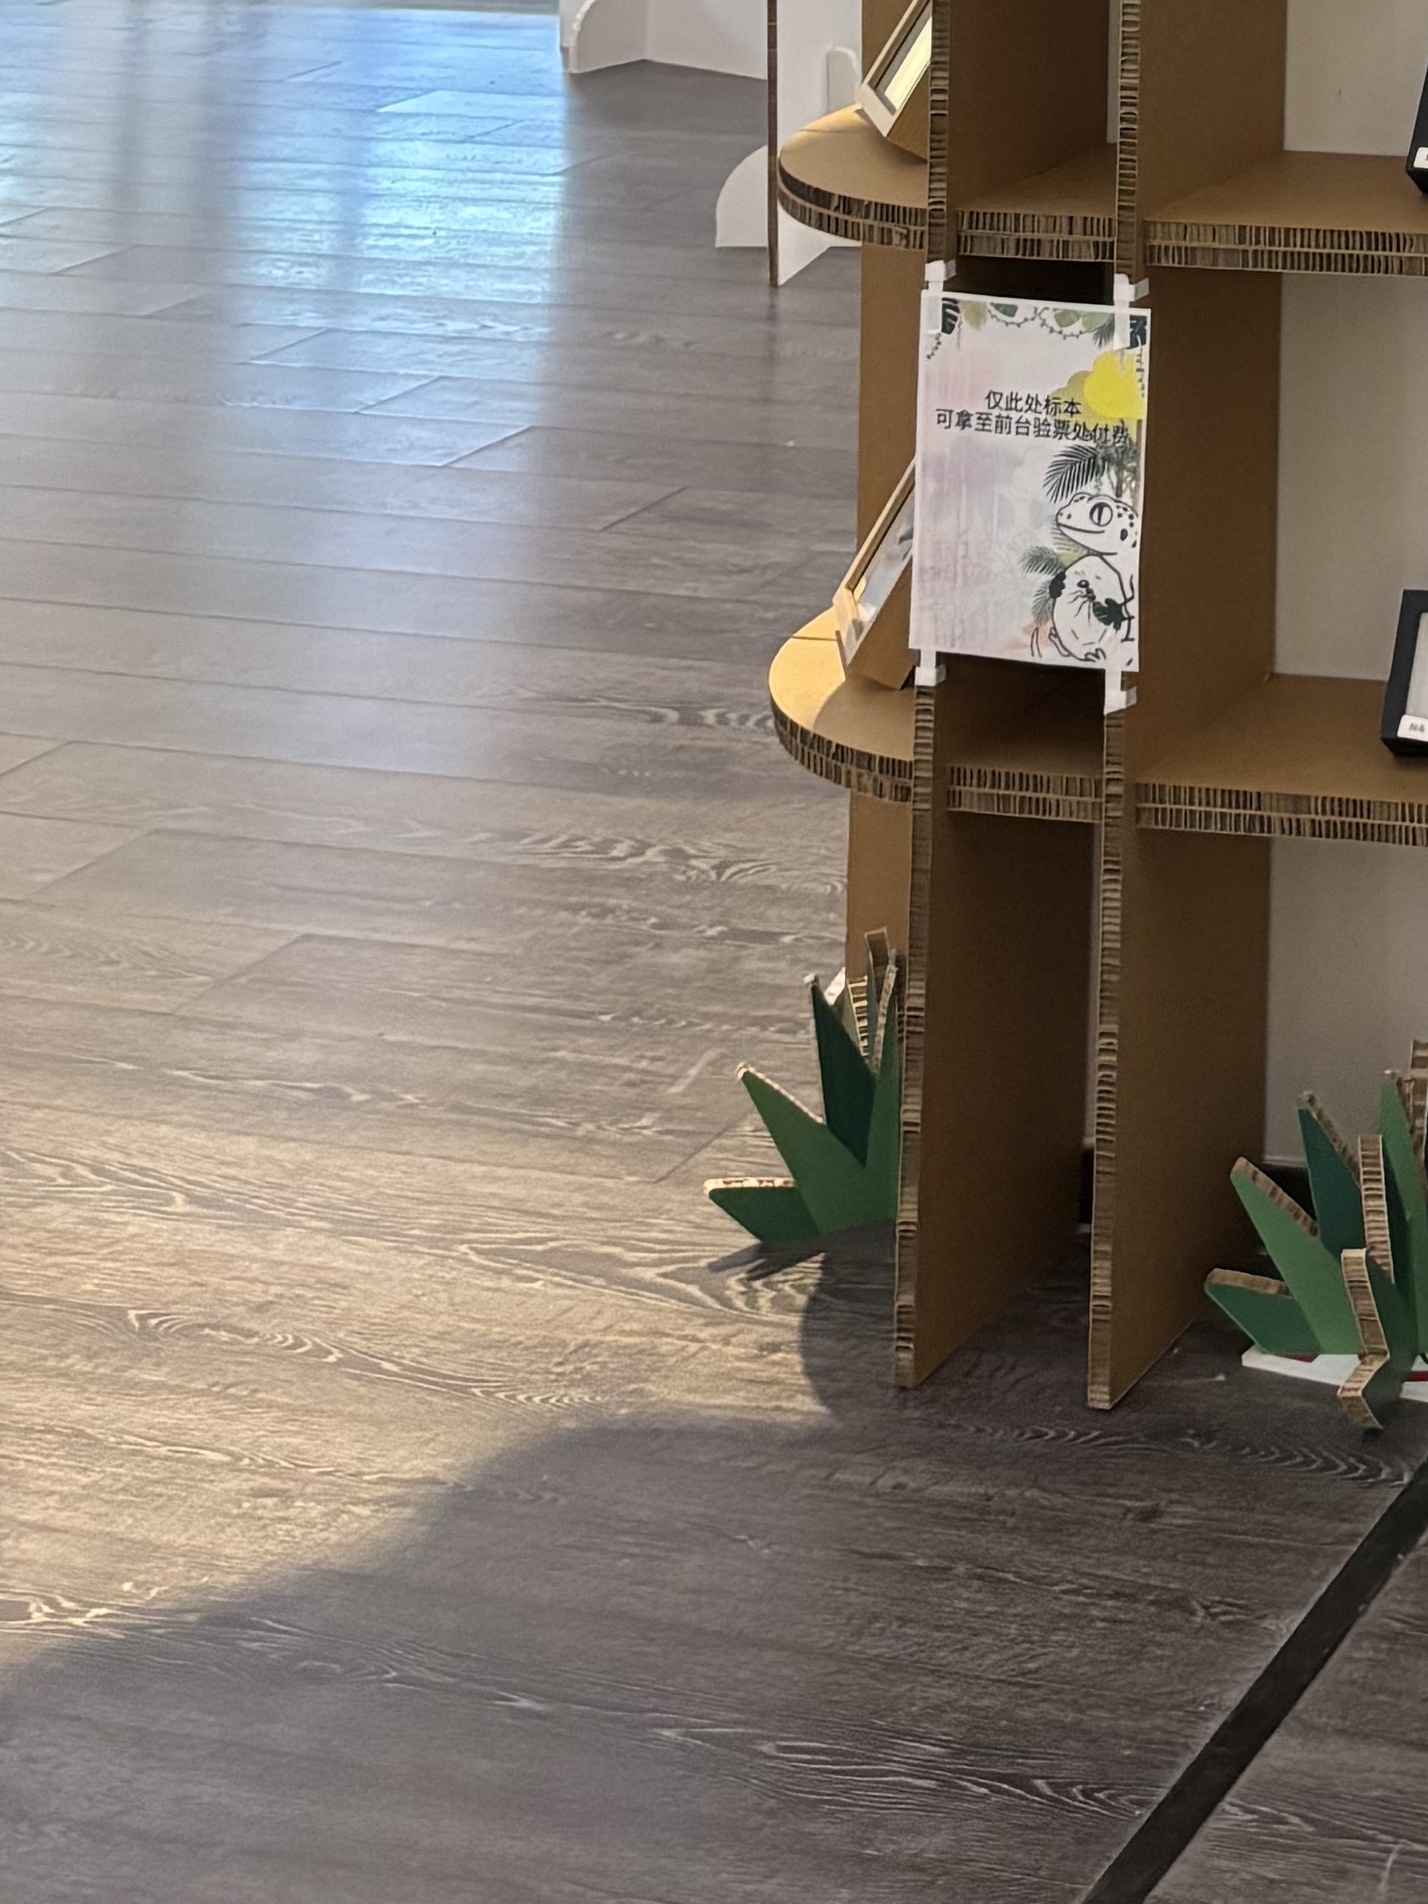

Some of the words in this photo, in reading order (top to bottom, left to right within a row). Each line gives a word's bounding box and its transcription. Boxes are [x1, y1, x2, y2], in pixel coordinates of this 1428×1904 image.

[985, 390, 1081, 417] 仅此处标本
[936, 408, 1129, 445] 可拿至前台验票处付费
